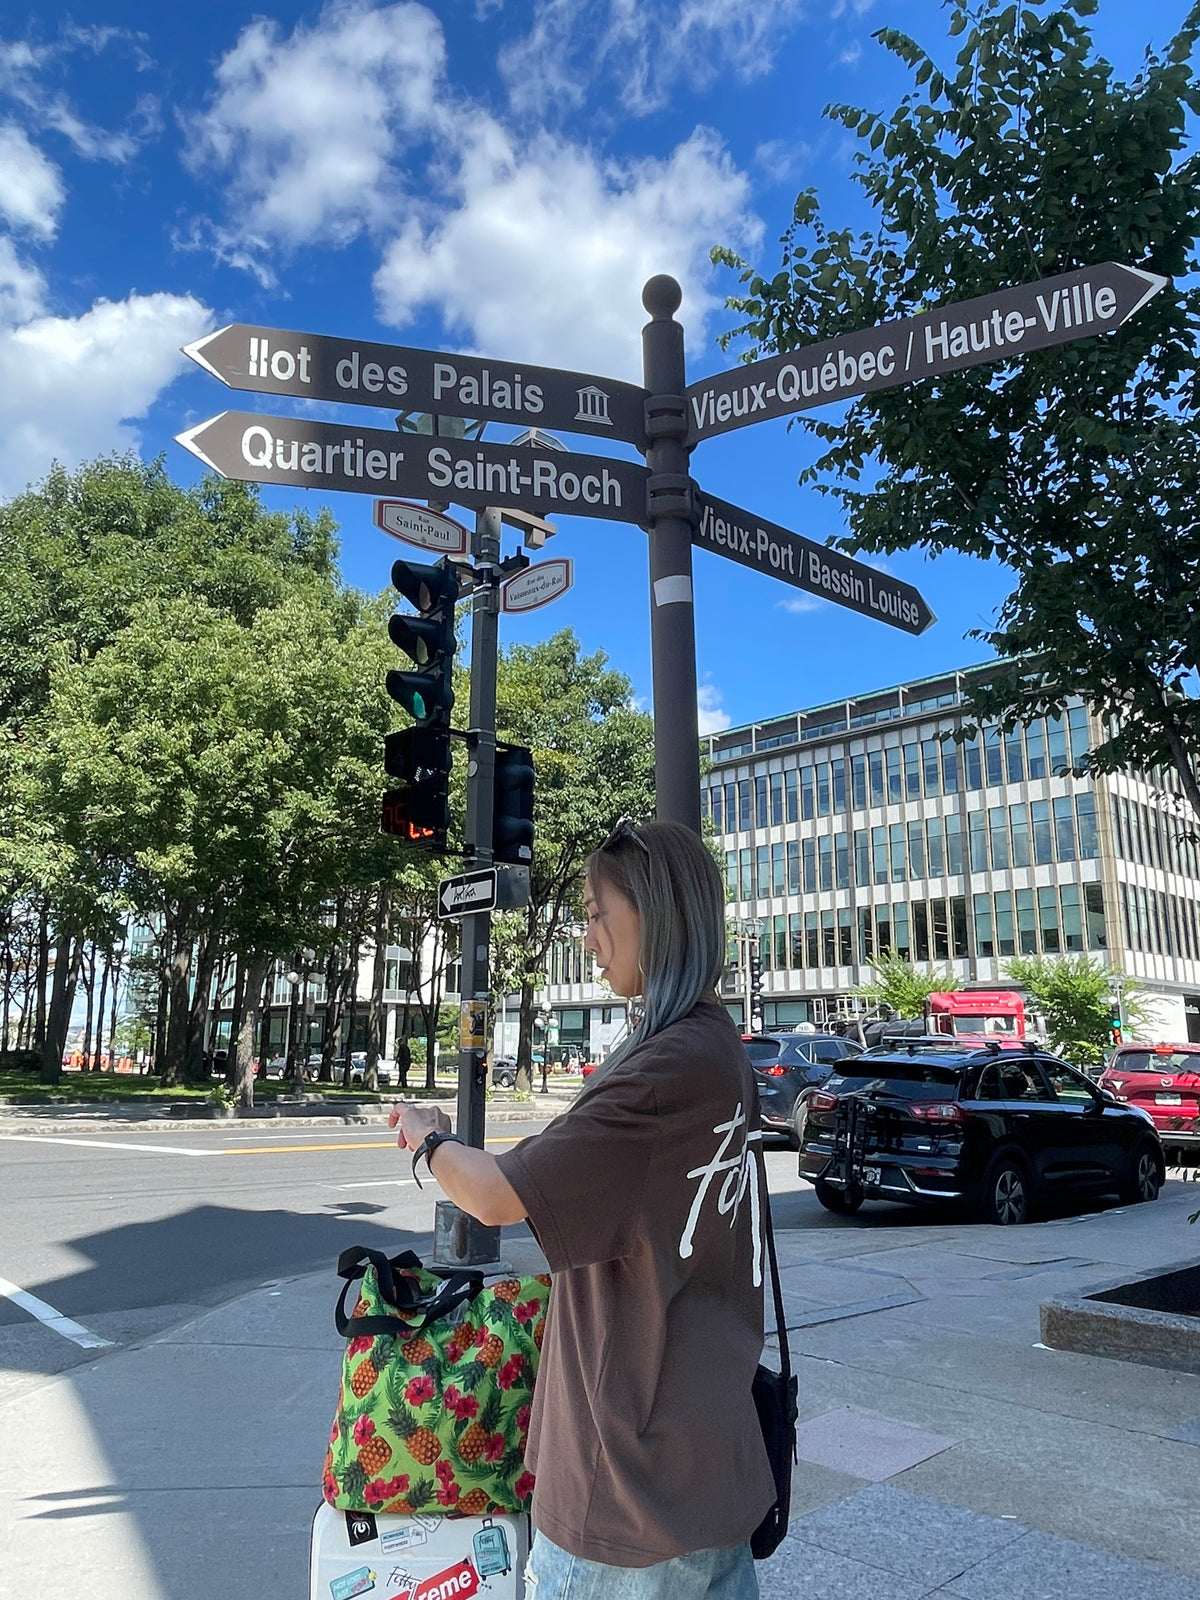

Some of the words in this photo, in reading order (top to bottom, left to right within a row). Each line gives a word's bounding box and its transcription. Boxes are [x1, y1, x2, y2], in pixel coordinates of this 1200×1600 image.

[335, 351, 409, 396] des
[433, 363, 545, 414] Palais
[691, 343, 896, 431] Vieux-Québec
[905, 331, 915, 371] /
[924, 281, 1118, 365] Haute-Ville
[241, 424, 404, 482] Quartier
[427, 447, 622, 507] Saint-Roch
[396, 515, 450, 542] Saint-Paul
[808, 550, 865, 604] Bassin
[868, 577, 919, 627] Louise
